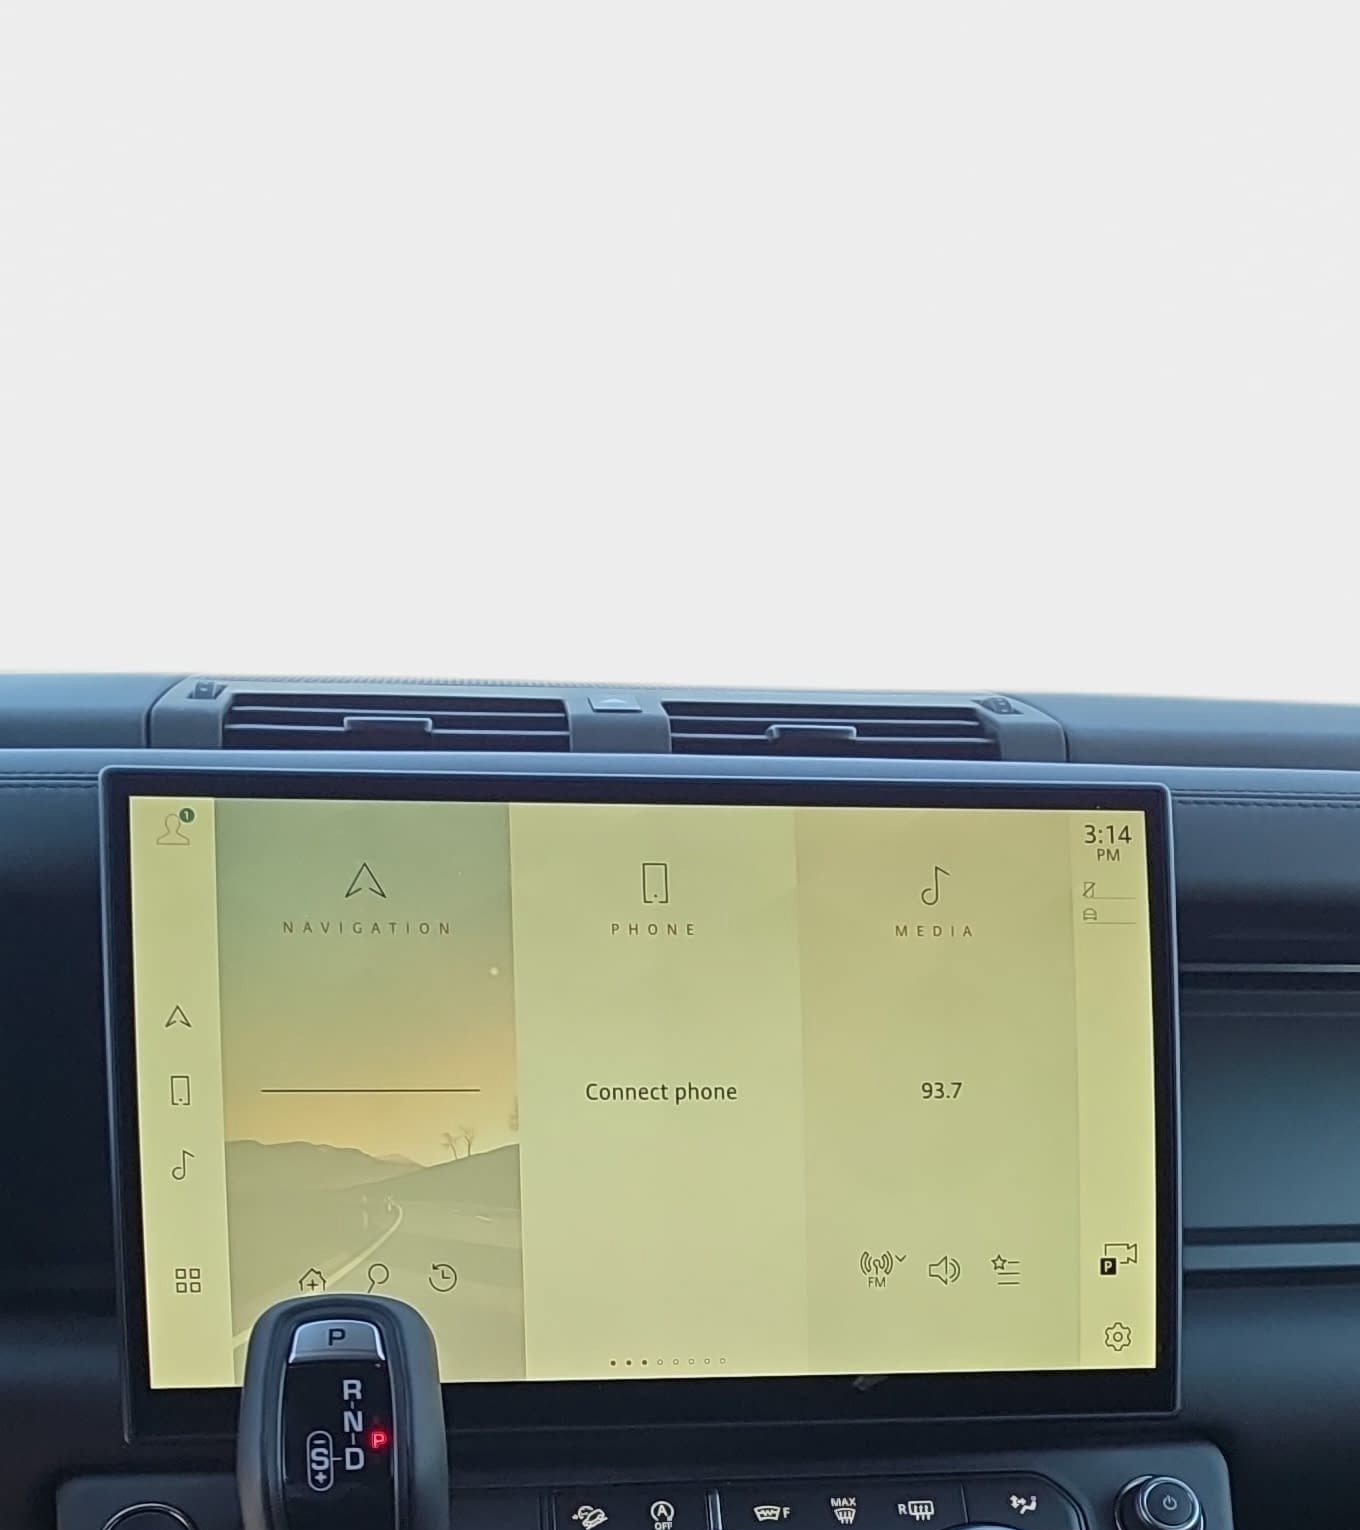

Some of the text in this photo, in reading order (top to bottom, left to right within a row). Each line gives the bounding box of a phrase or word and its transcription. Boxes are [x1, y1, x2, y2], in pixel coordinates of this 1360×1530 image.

[1083, 825, 1133, 845] 3:14
[1096, 848, 1121, 862] PM
[282, 921, 452, 936] NAVIGATION
[611, 923, 696, 937] PHONE
[895, 925, 974, 938] MEDIA
[585, 1081, 738, 1105] Connect phone
[921, 1081, 963, 1100] 93.7
[867, 1276, 887, 1288] FM
[327, 1328, 346, 1347] P
[343, 1379, 362, 1400] R
[343, 1410, 364, 1432] N
[310, 1447, 330, 1470] S
[344, 1447, 365, 1470] D
[830, 1497, 857, 1508] MAX
[654, 1521, 673, 1530] OFF
